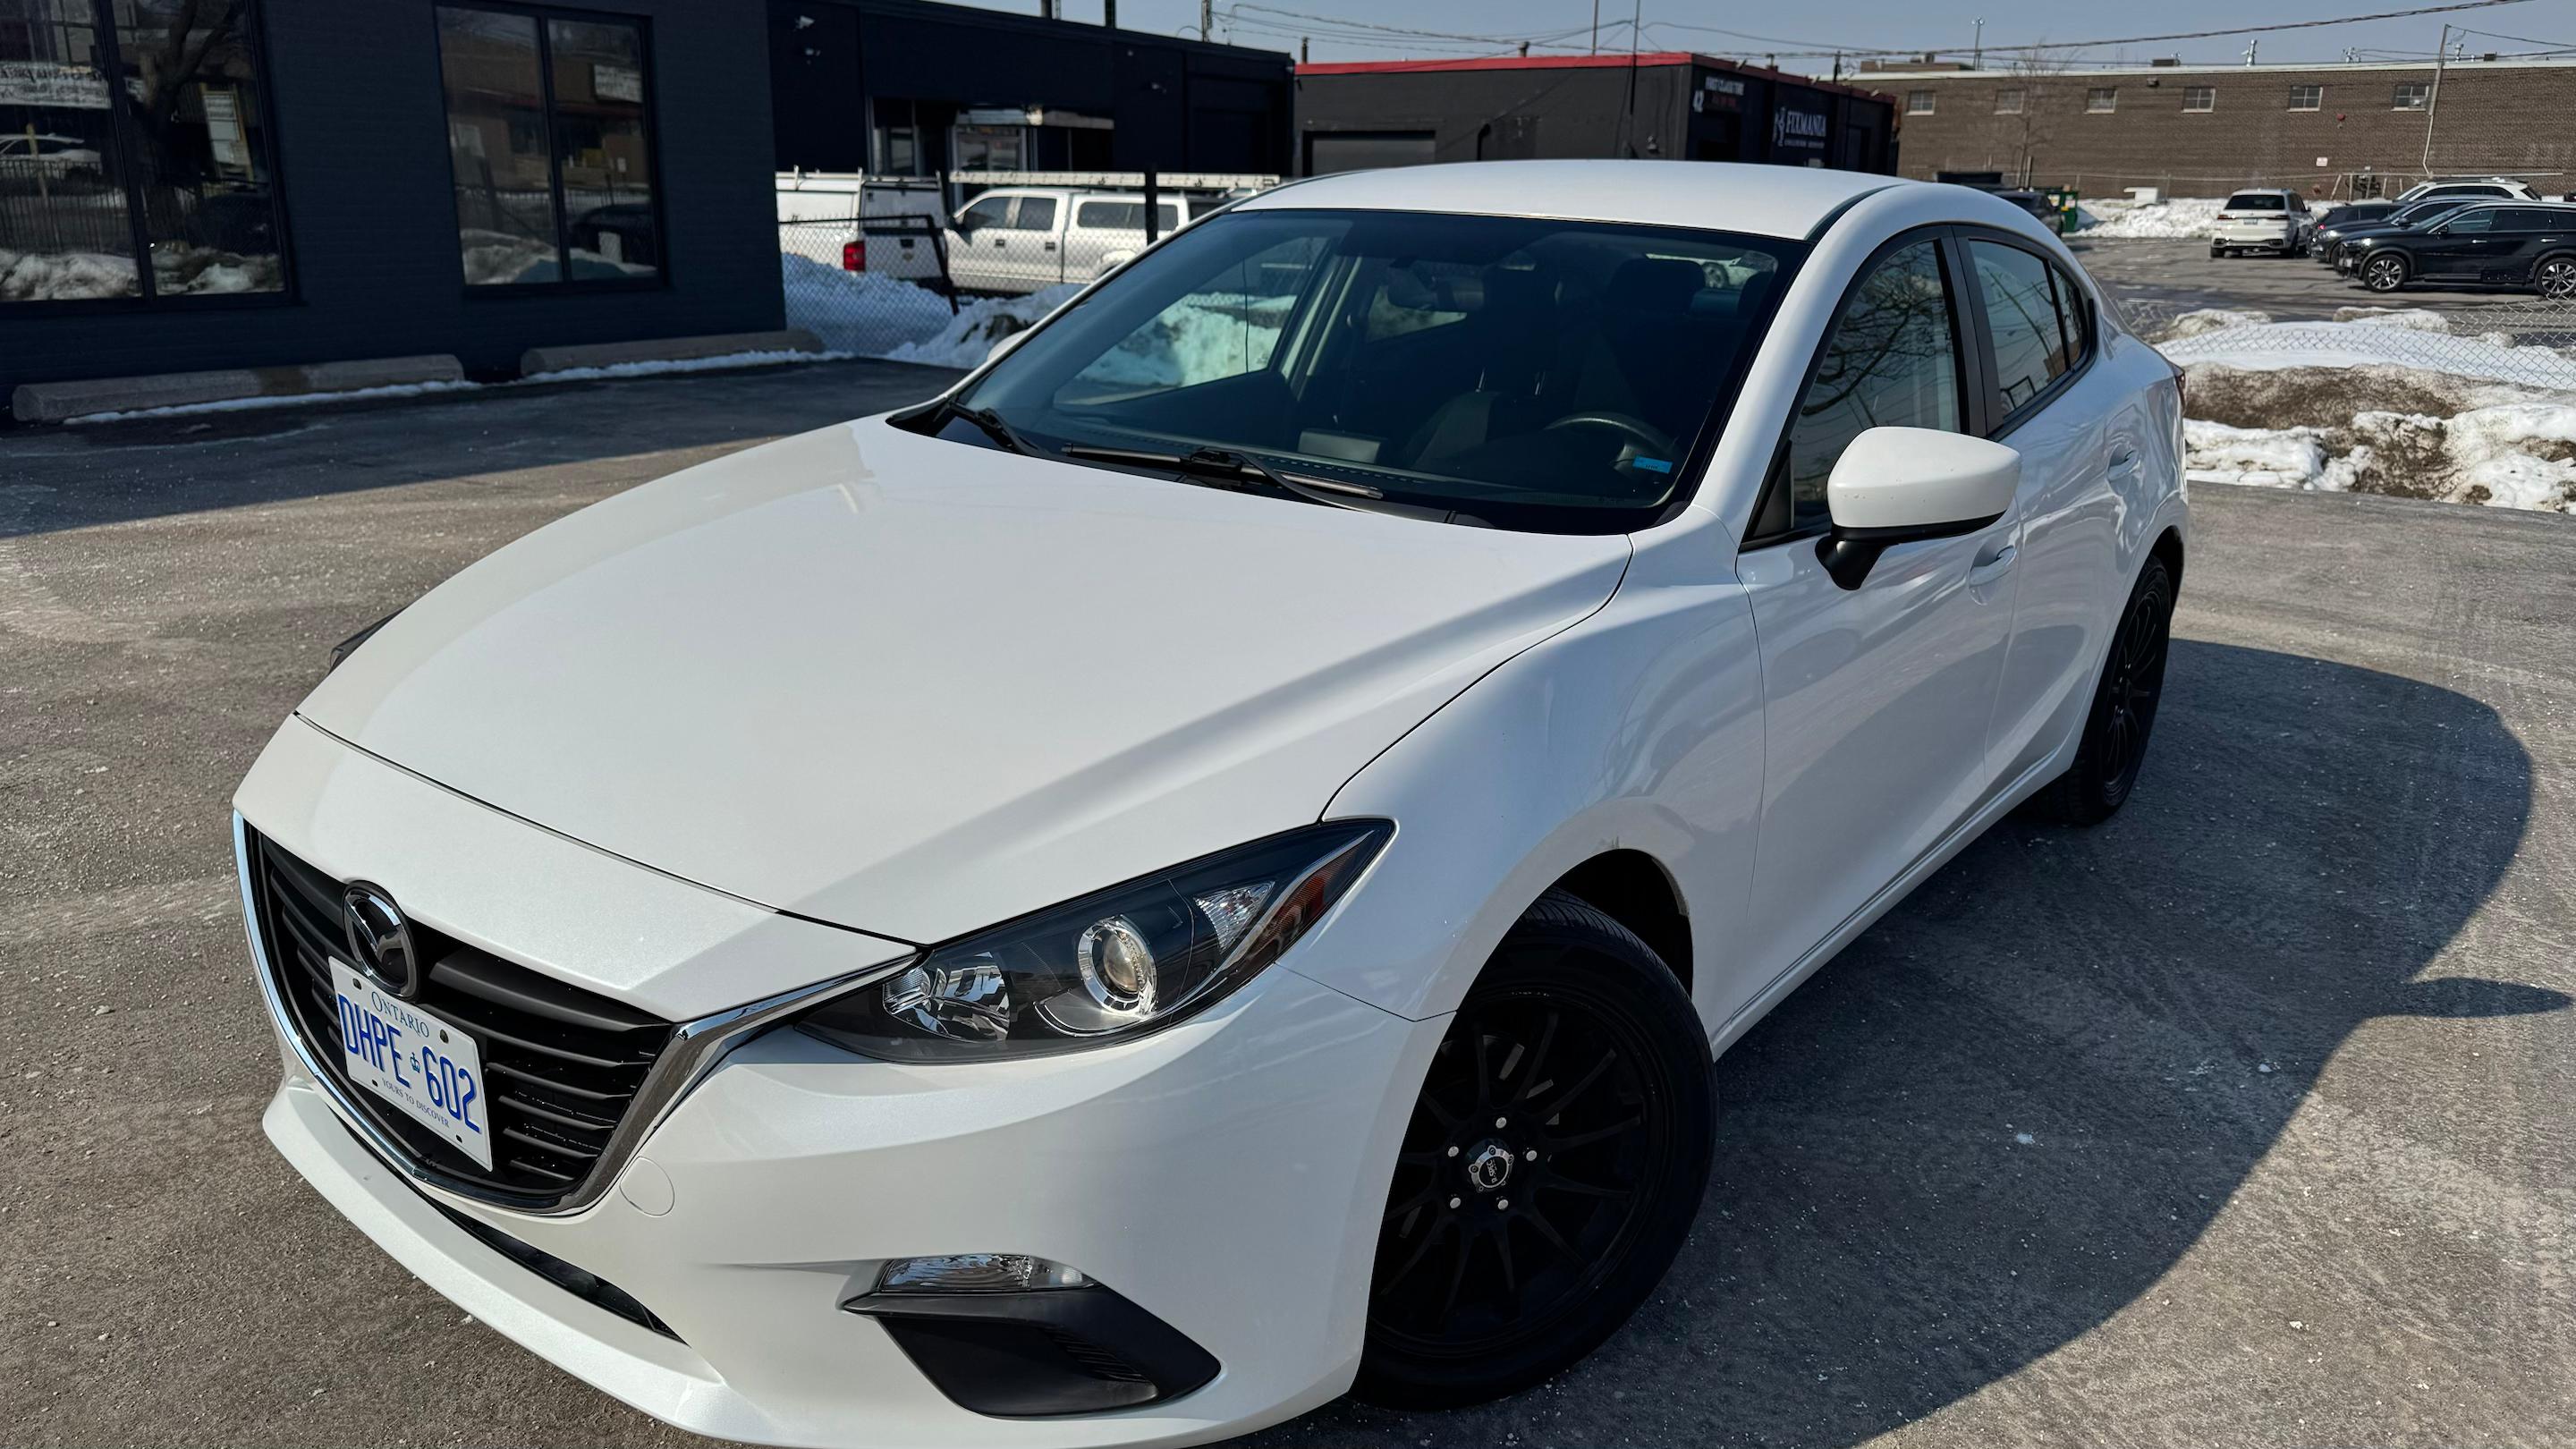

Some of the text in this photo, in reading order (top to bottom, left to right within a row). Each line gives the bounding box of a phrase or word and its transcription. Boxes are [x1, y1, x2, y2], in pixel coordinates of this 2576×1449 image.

[371, 991, 429, 1038] ONTARIO
[338, 993, 482, 1134] DHPE 602
[382, 1077, 450, 1129] YOURS TO DISCOVER
